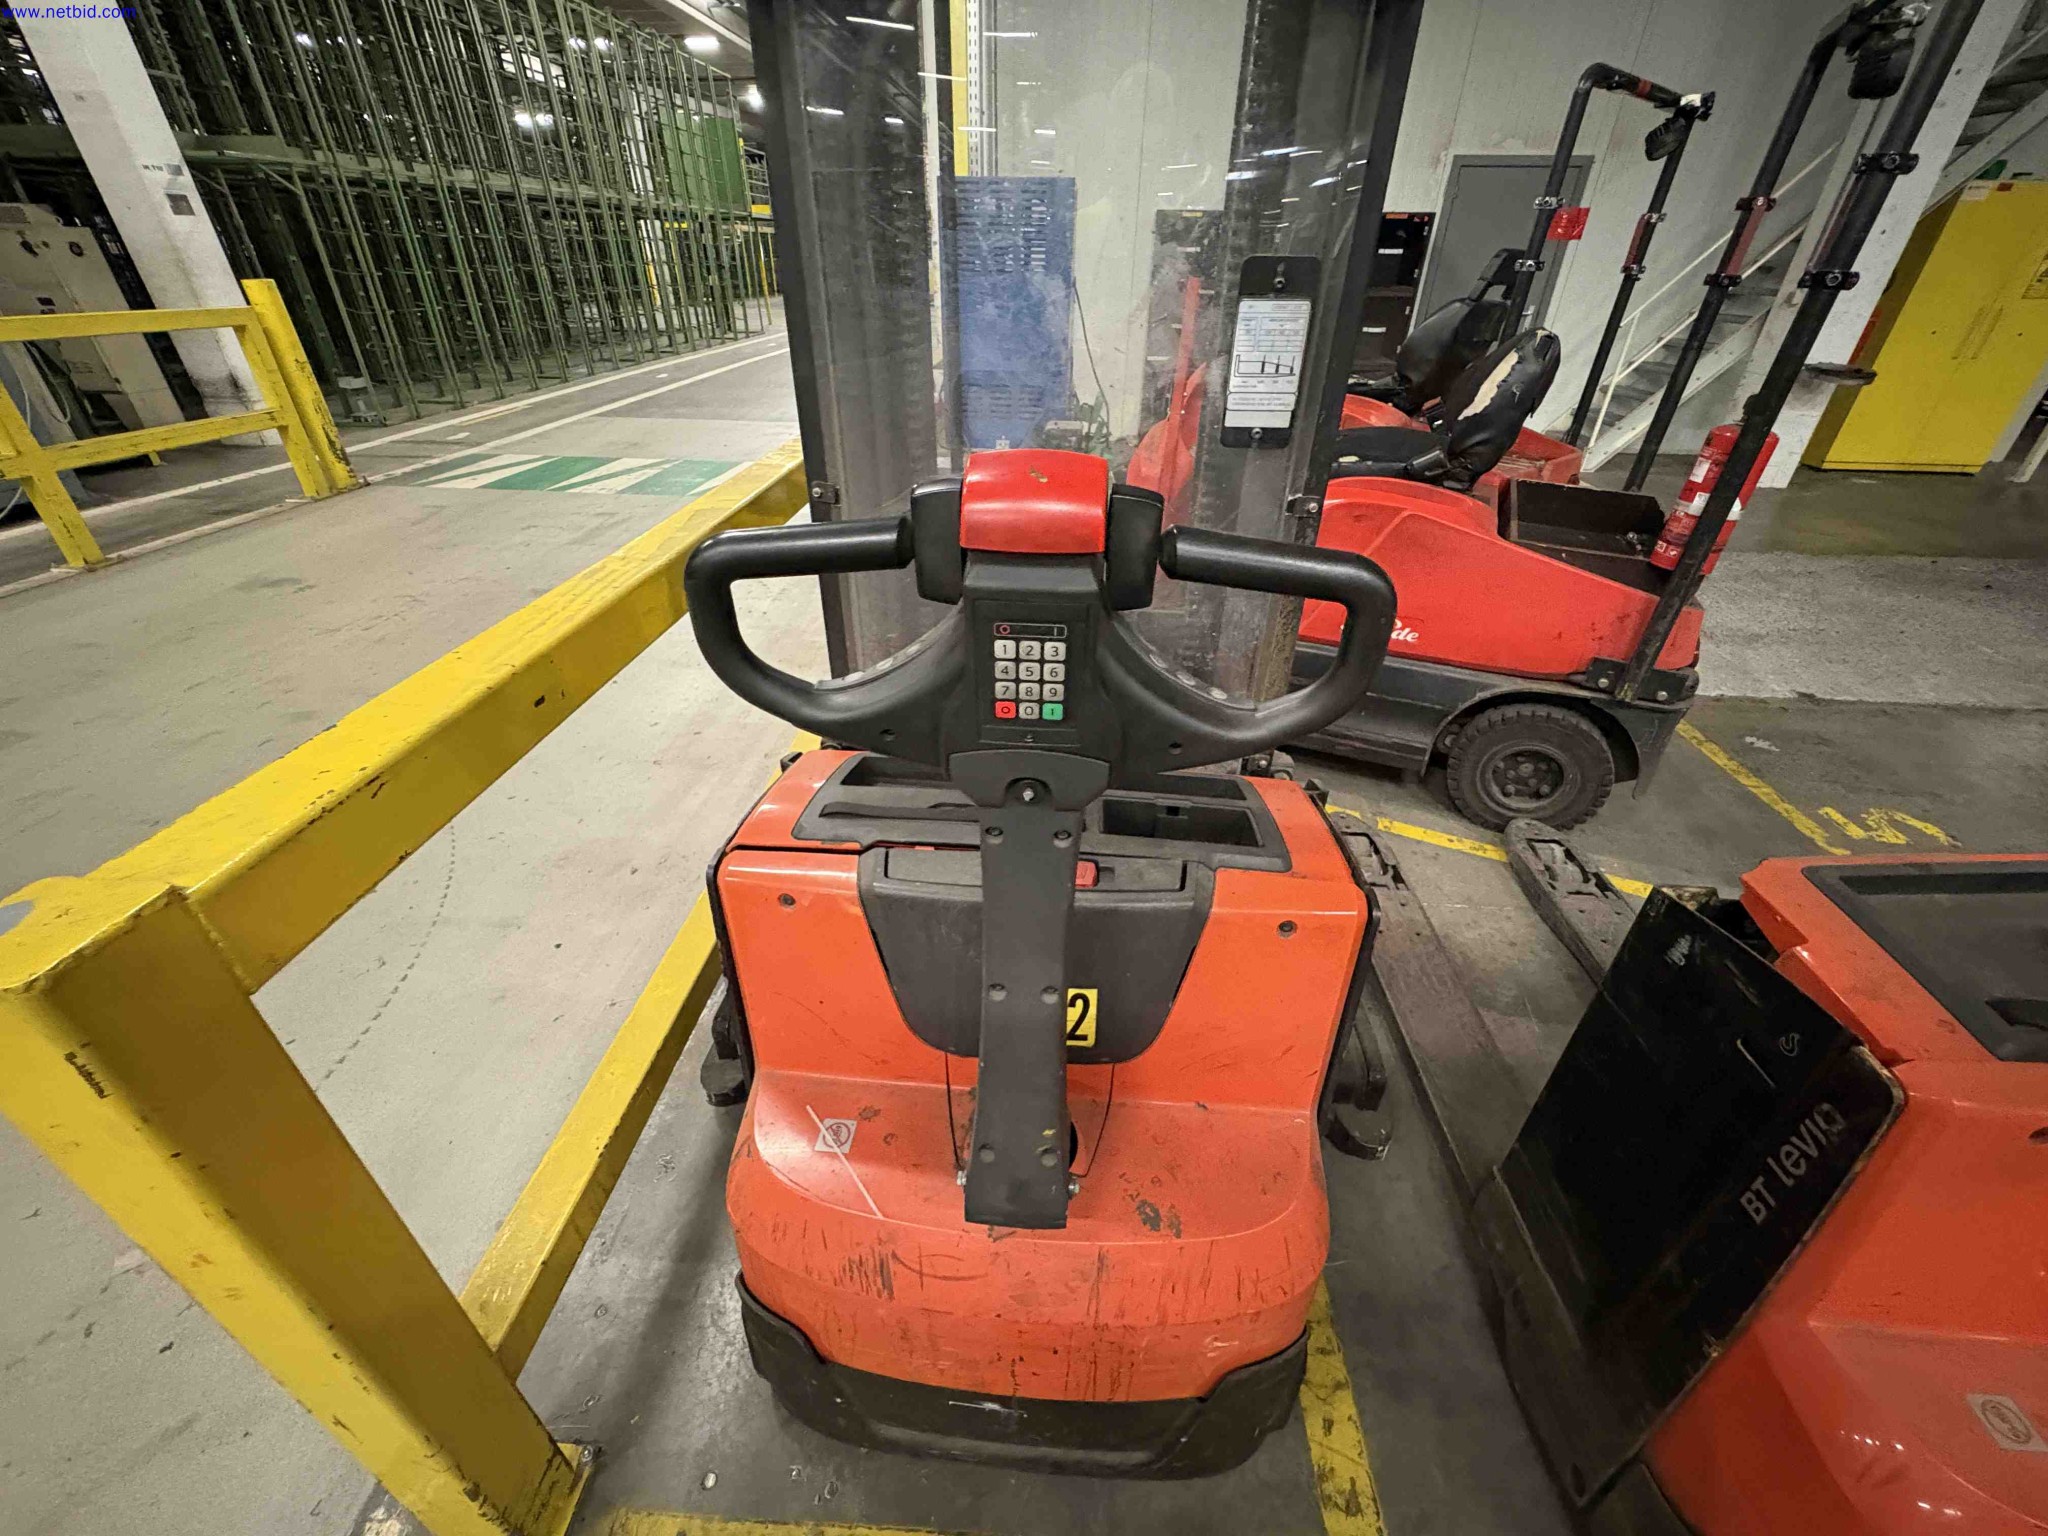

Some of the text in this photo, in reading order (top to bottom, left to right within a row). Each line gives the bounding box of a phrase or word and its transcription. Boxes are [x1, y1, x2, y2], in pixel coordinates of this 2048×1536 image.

[1002, 644, 1059, 657] 1 2 3
[1001, 665, 1058, 678] 4 5 6
[1001, 685, 1058, 698] 7 8 9
[1066, 992, 1090, 1041] 2
[1739, 1175, 1777, 1226] BT
